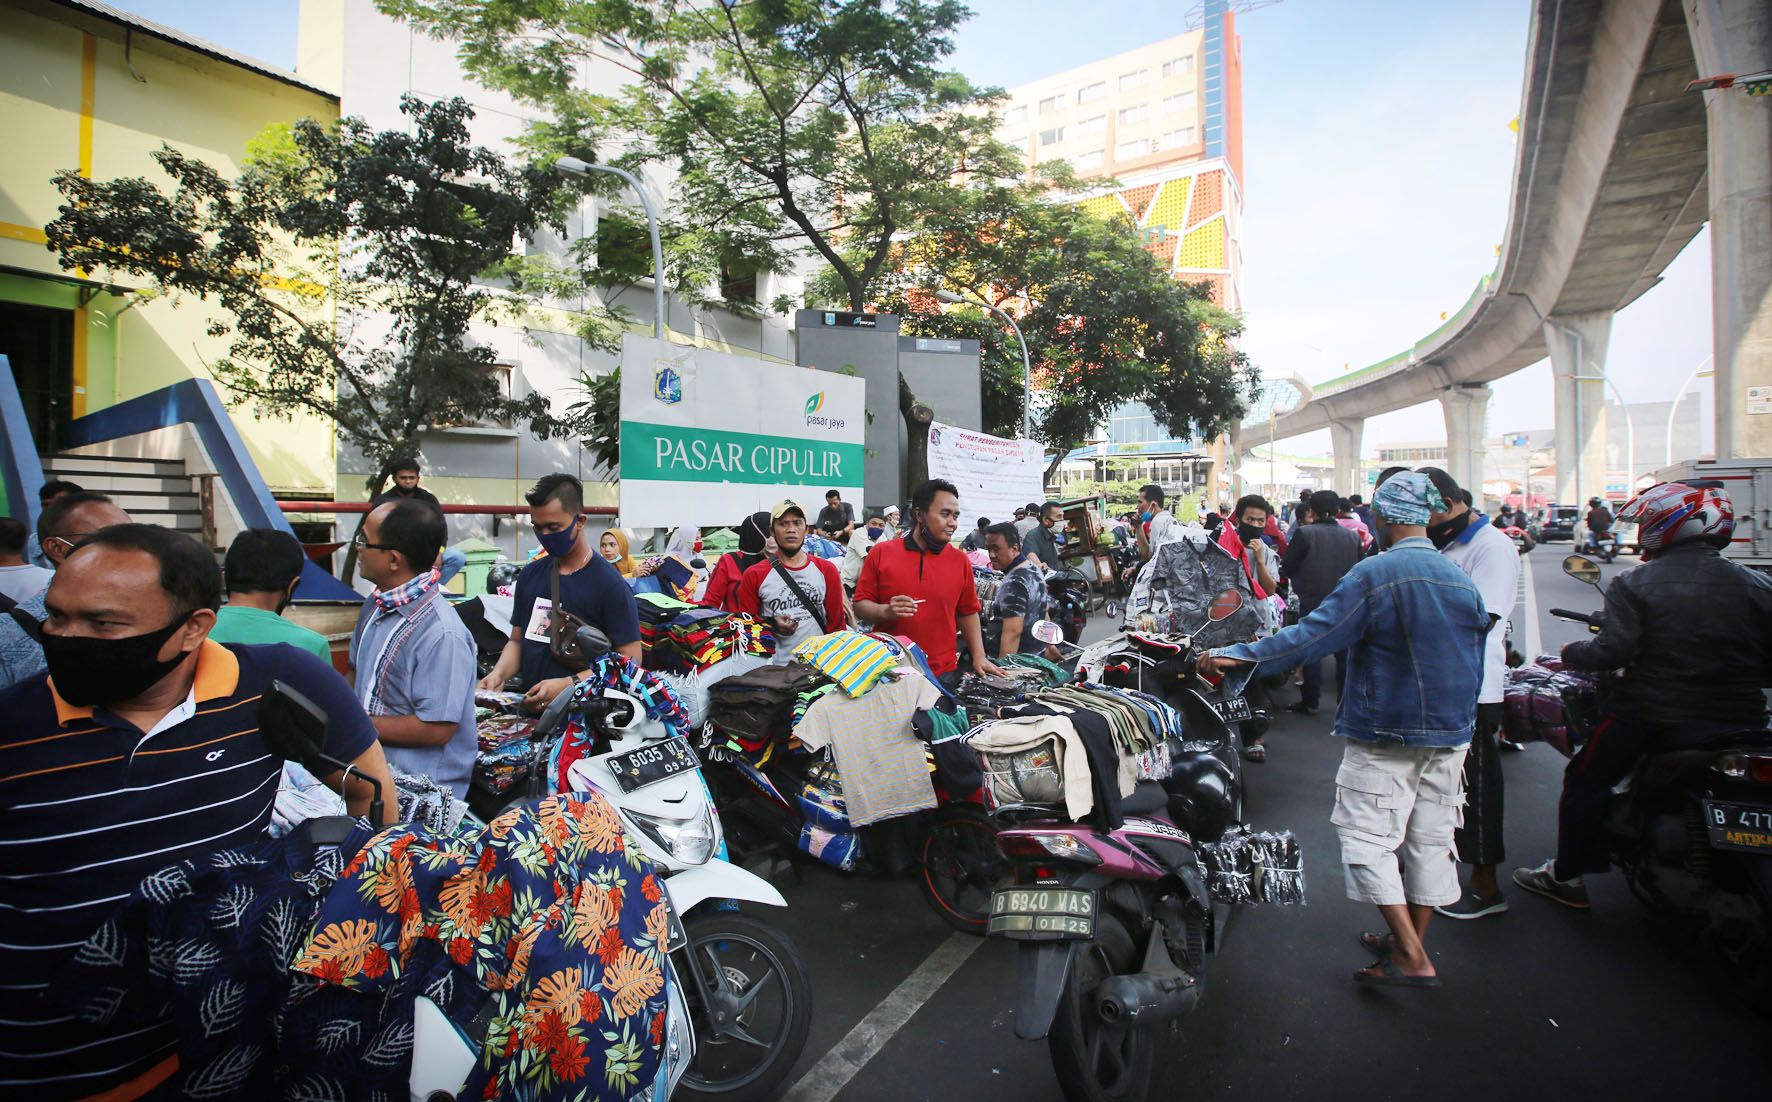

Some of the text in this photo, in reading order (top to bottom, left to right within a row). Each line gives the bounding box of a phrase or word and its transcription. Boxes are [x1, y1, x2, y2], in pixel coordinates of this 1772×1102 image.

[807, 416, 845, 430] pasar jaya
[653, 436, 843, 478] PASAR CIPULIR
[1227, 698, 1244, 710] VPF
[609, 759, 623, 774] B
[628, 746, 664, 768] 6035
[1713, 808, 1726, 825] B
[996, 892, 1091, 913] B 6940 VAS
